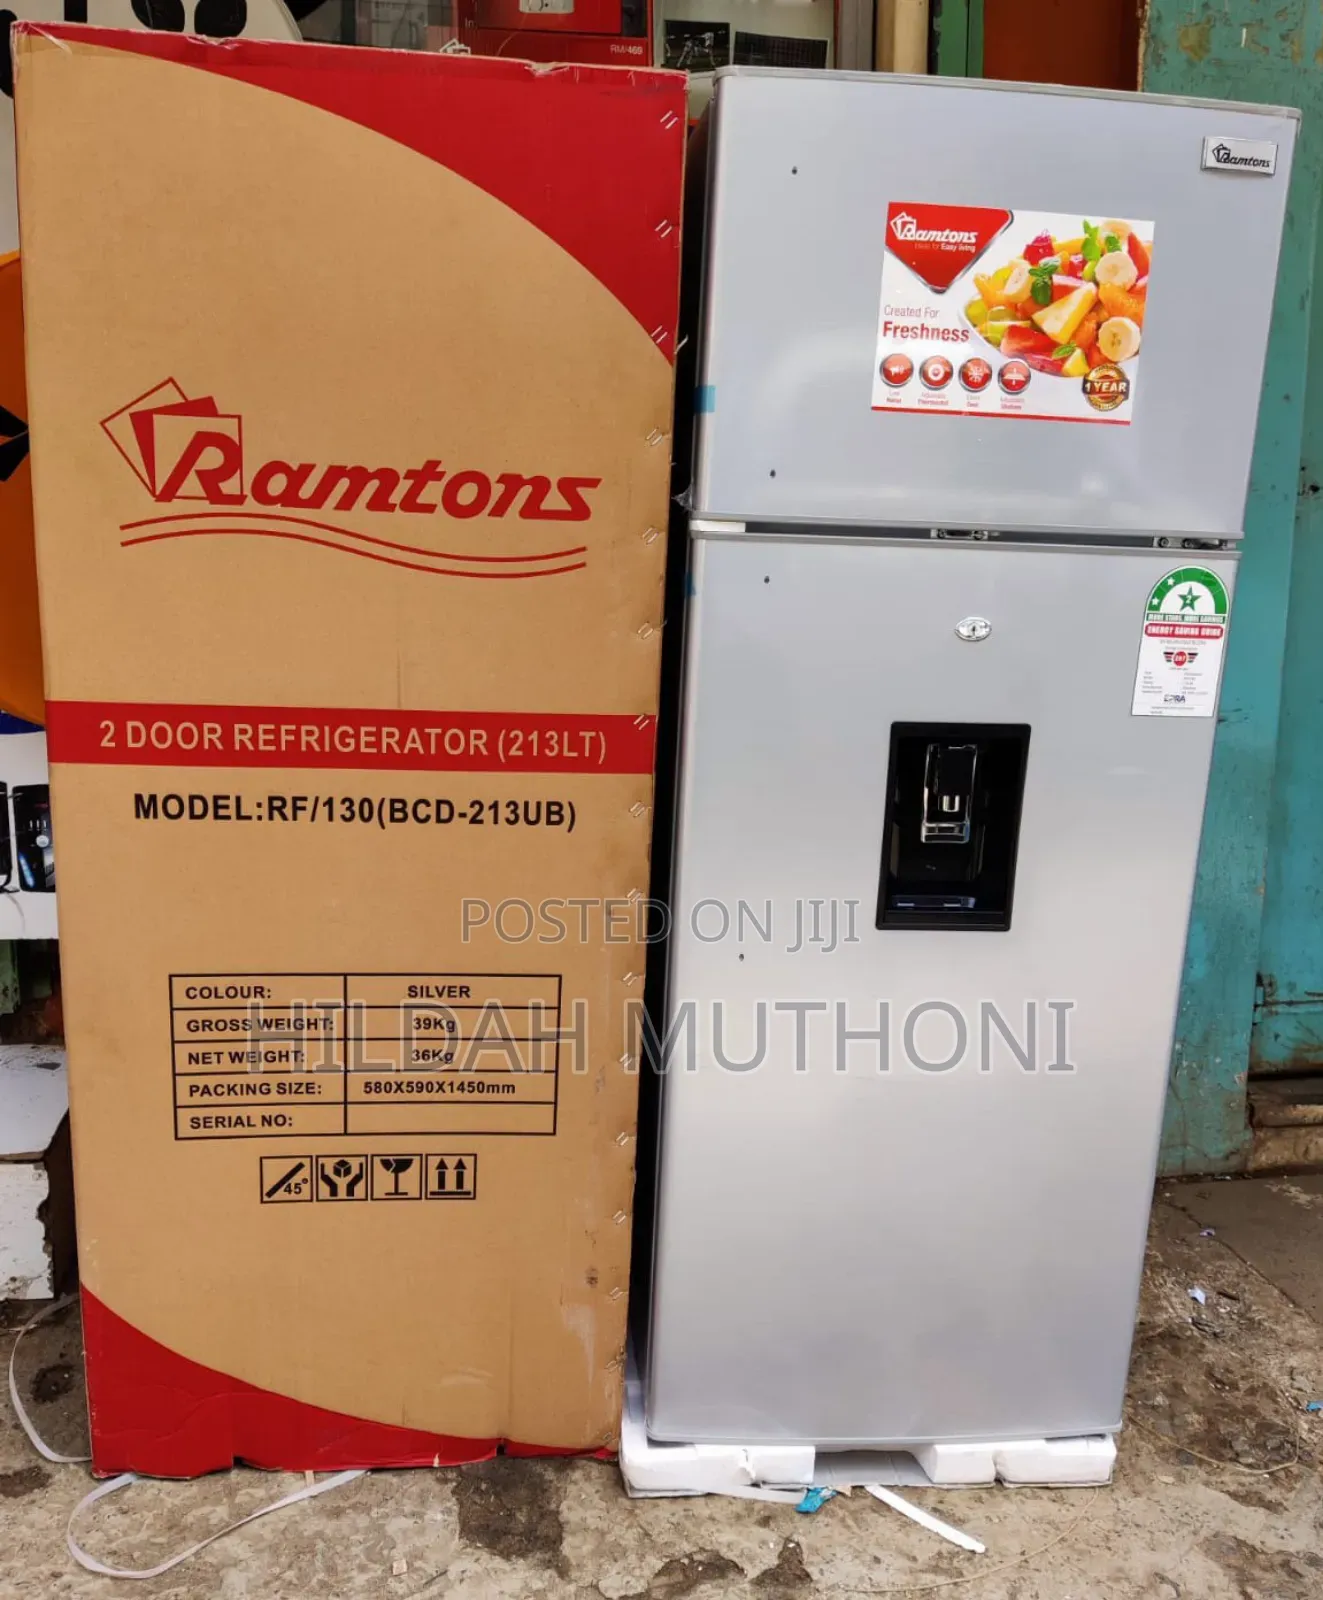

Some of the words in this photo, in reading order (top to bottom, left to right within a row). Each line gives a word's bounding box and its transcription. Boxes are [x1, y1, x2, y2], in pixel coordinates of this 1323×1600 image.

[1219, 151, 1271, 168] Ramtons
[899, 222, 979, 244] Ramtons
[941, 243, 957, 252] Easy
[884, 304, 922, 317] Created
[924, 307, 940, 318] For
[882, 320, 970, 342] Freshness
[1085, 382, 1091, 392] 1
[1093, 382, 1127, 392] YEAR
[154, 430, 602, 522] Ramtons
[1147, 626, 1174, 635] ENERGY
[1175, 626, 1199, 636] SAVING
[99, 720, 116, 748] 2
[126, 721, 224, 750] DOOR
[233, 723, 489, 757] REFRIGERATOR
[498, 729, 607, 765] (213LT)
[133, 792, 577, 834] MODEL:RF/130(BCD-213UB)
[185, 985, 272, 1000] COLOUR:
[407, 985, 471, 999] SILVER
[186, 1019, 253, 1033] GROSS
[257, 1017, 334, 1031] WEIGHT:
[413, 1018, 456, 1033] 39Kg
[188, 1052, 224, 1065] NET
[228, 1050, 305, 1064] WEIGHT:
[411, 1049, 454, 1064] 36Kg
[189, 1083, 272, 1098] PACKING
[276, 1082, 322, 1096] SIZE:
[363, 1081, 516, 1095] 580X590X1450mm
[190, 1115, 256, 1130] SERIAL
[261, 1114, 293, 1128] NO:
